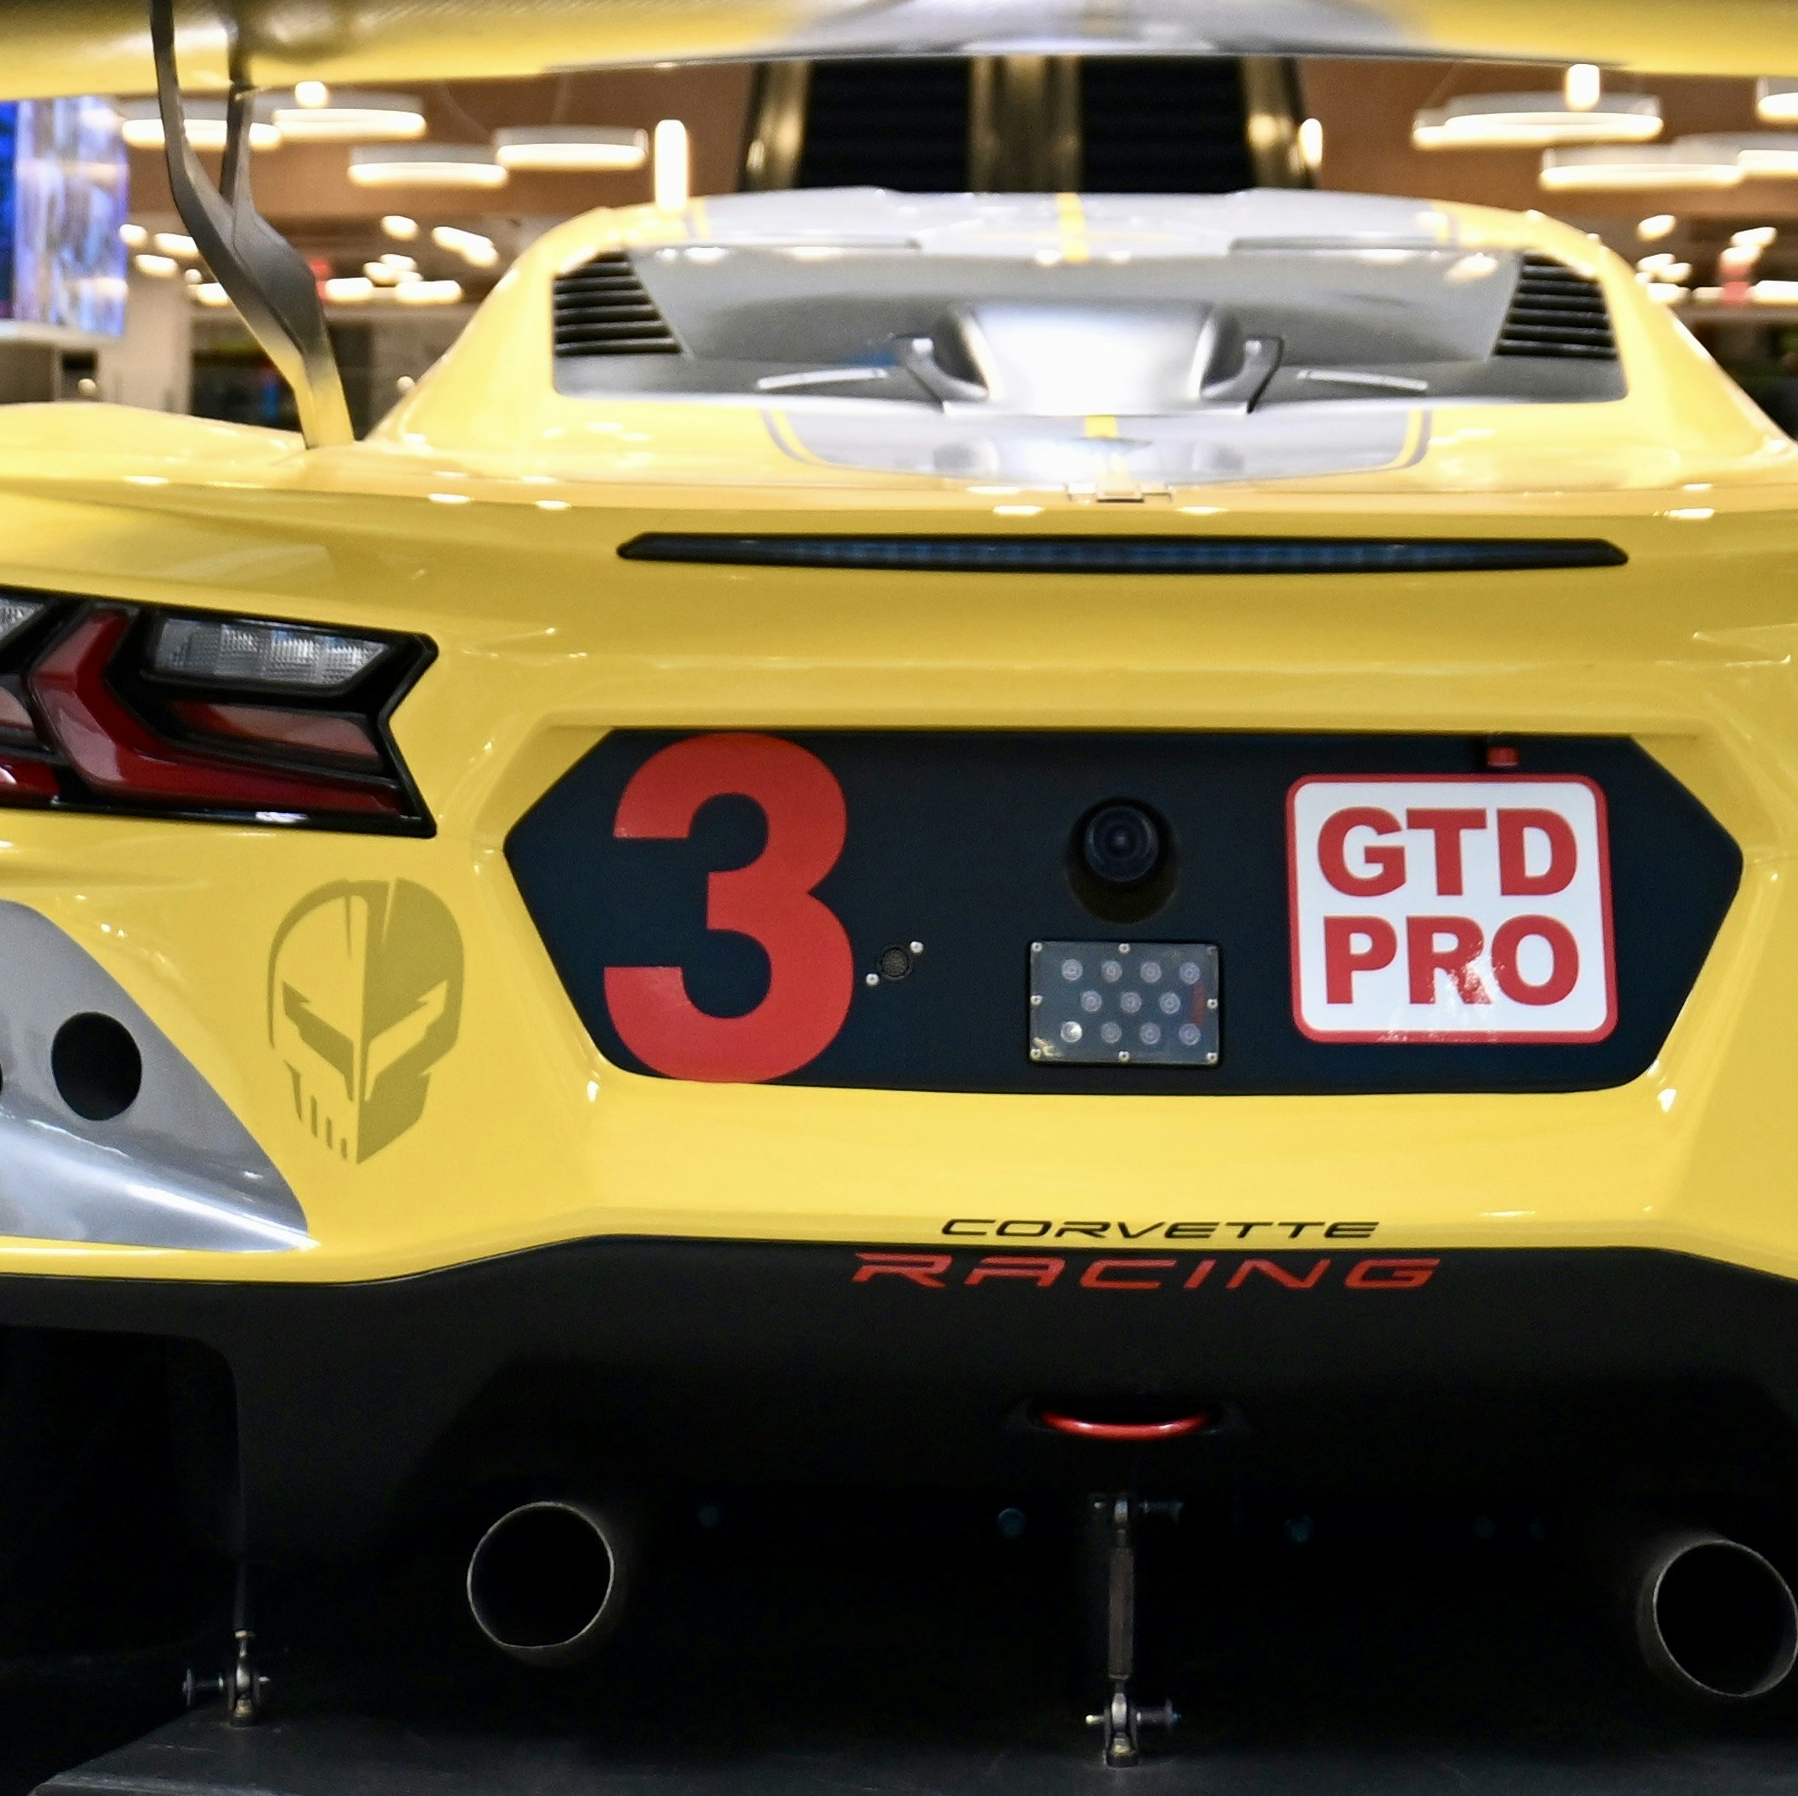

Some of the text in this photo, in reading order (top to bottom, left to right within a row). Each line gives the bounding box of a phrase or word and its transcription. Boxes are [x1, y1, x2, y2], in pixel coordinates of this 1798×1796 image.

[1317, 807, 1578, 897] GTD
[604, 732, 854, 1084] 3
[1324, 915, 1581, 1006] PRO
[851, 1252, 1441, 1289] RACING
[941, 1218, 1380, 1239] CORVETTE
